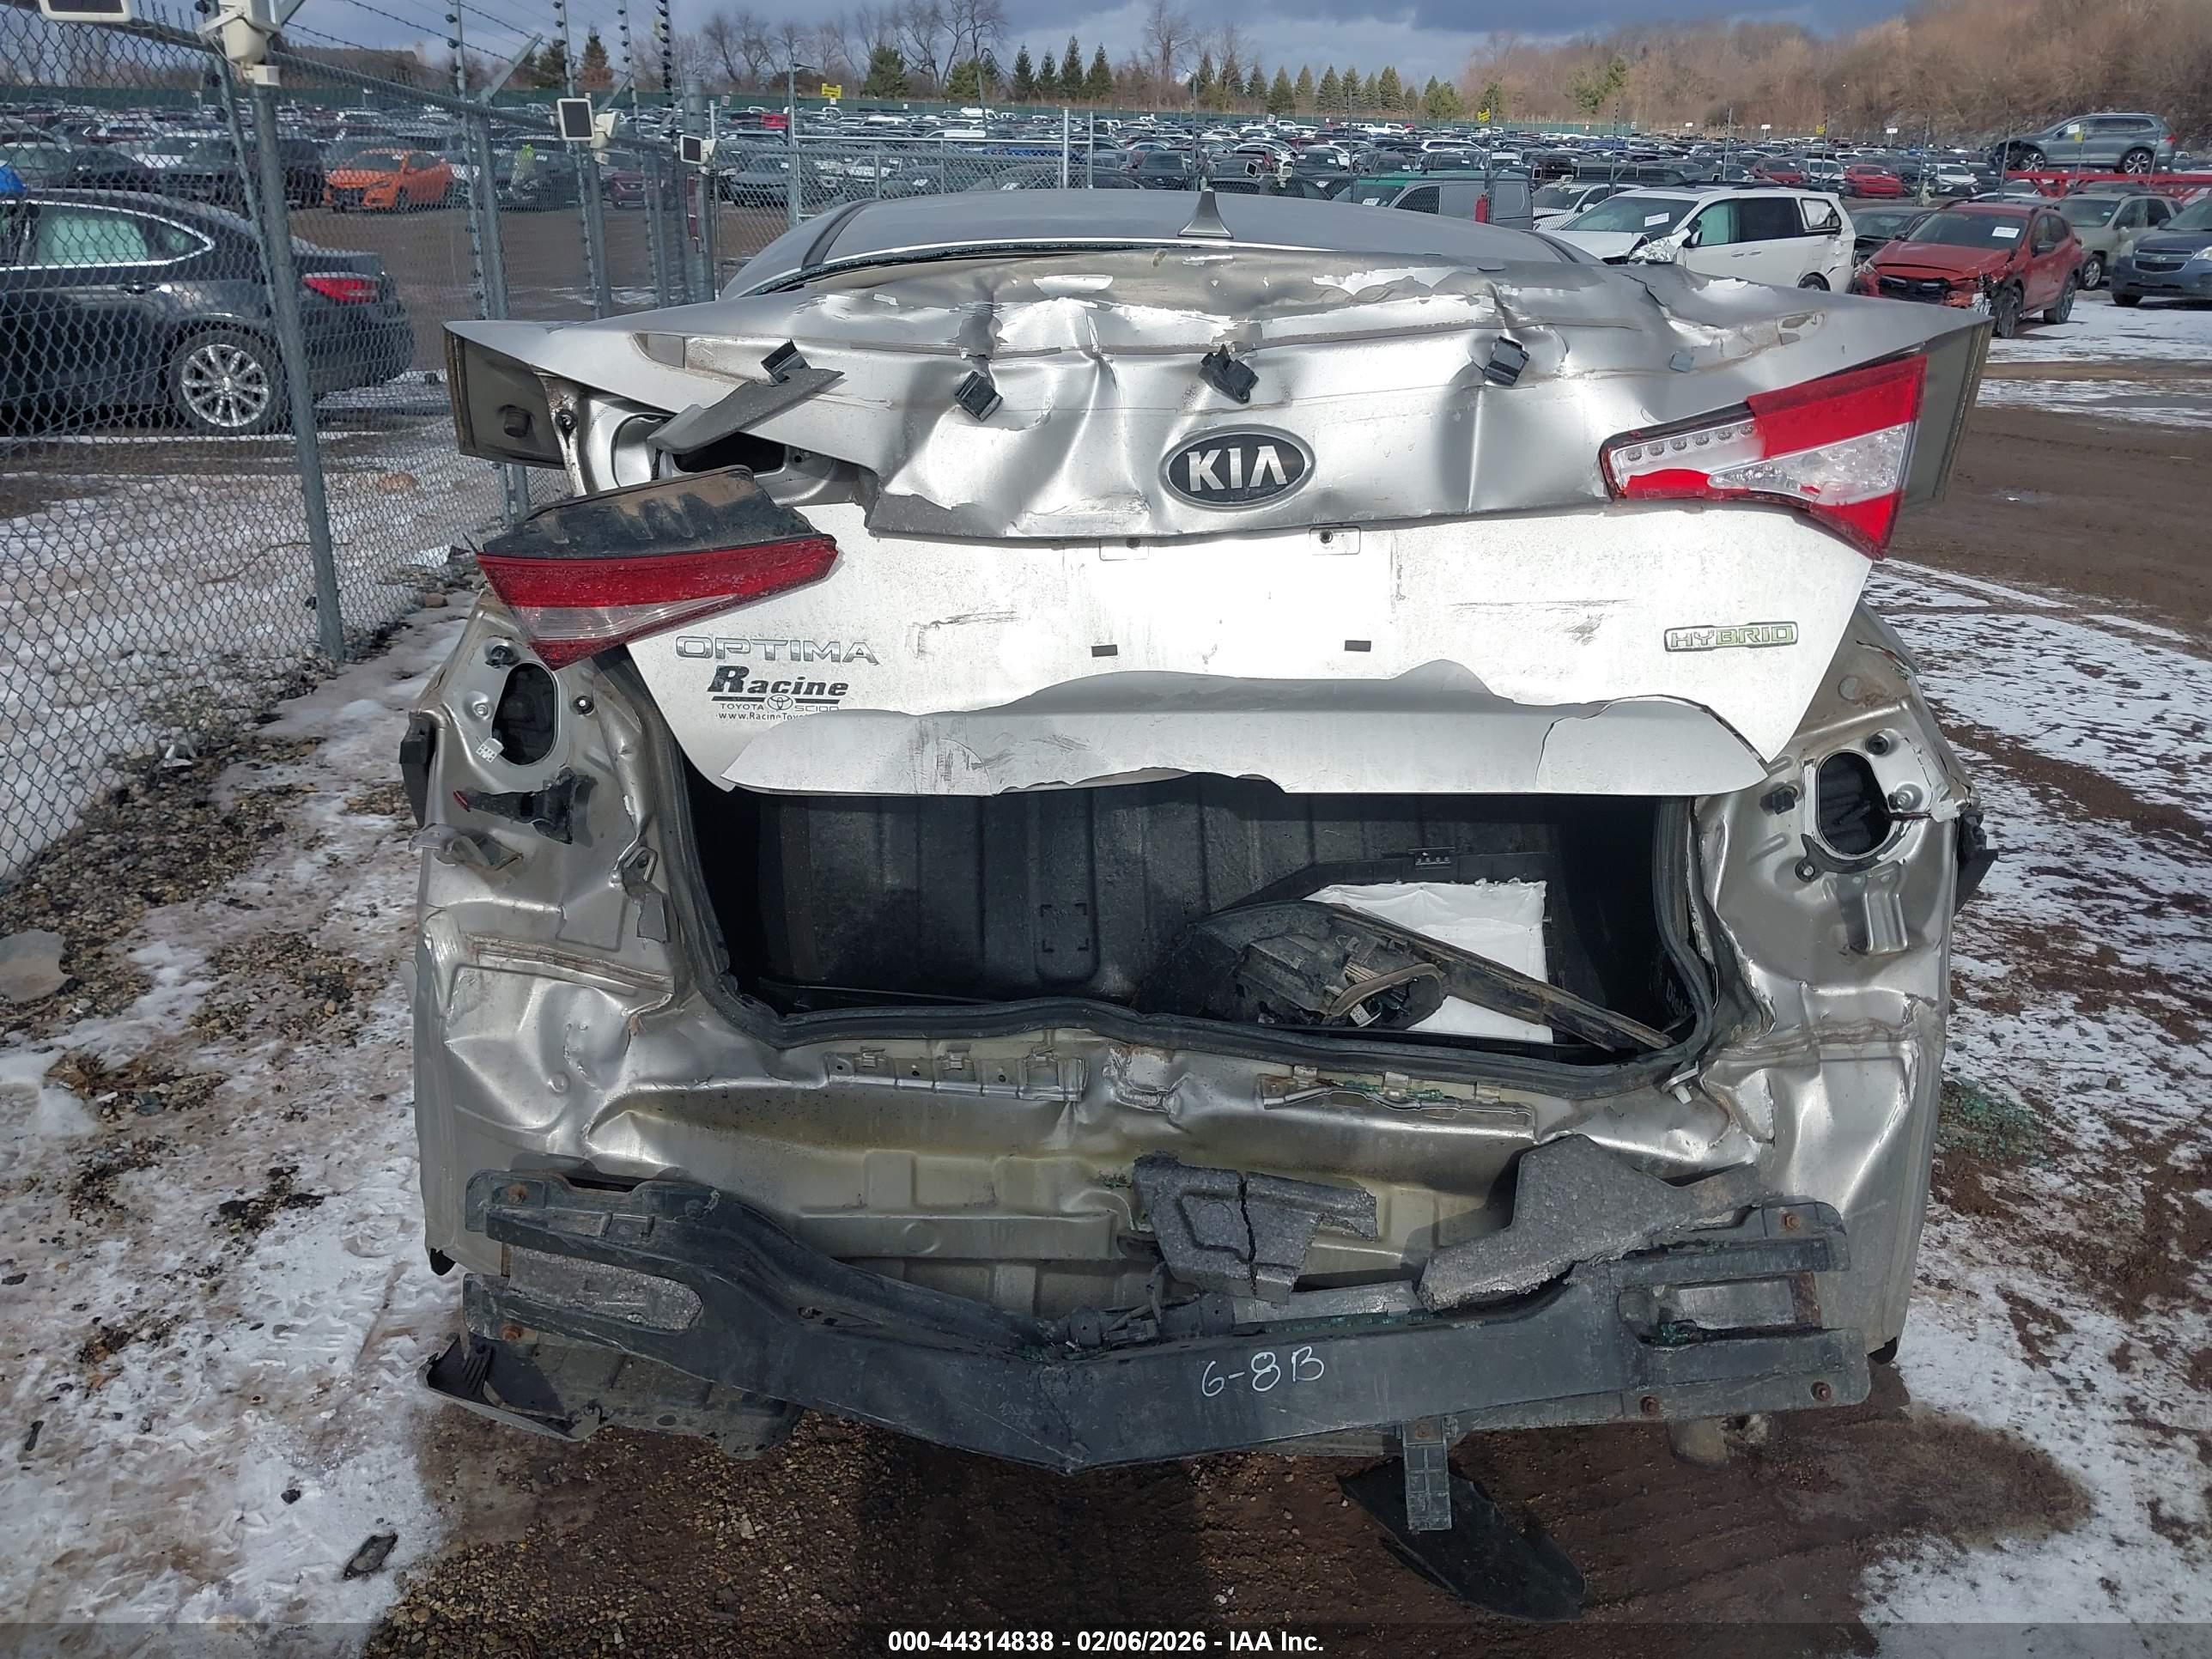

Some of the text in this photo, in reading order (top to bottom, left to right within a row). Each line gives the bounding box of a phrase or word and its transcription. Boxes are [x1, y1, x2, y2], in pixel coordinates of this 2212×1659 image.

[1187, 446, 1288, 492] KIA
[676, 635, 878, 665] OPTIMA
[1670, 625, 1794, 647] HYBRID
[707, 665, 849, 696] Racine
[1202, 1346, 1325, 1397] 6-8B
